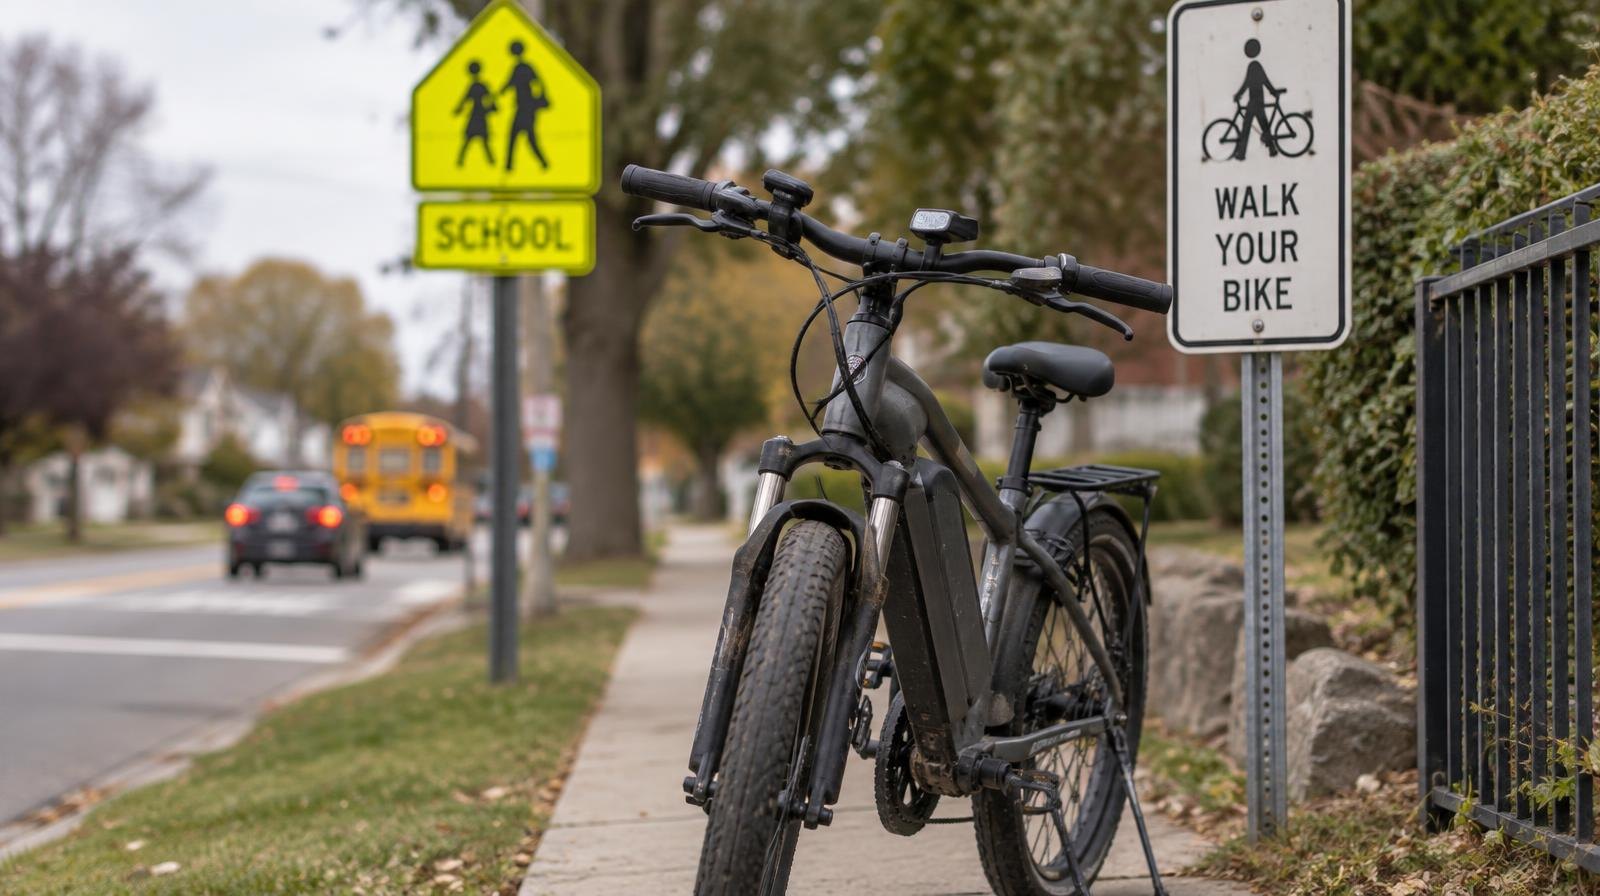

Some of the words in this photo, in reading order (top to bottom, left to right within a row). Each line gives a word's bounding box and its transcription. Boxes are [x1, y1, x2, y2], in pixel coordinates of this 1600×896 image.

[1215, 183, 1299, 219] WALK
[436, 216, 571, 250] SCHOOL
[1215, 230, 1298, 266] YOUR
[1223, 277, 1292, 312] BIKE
